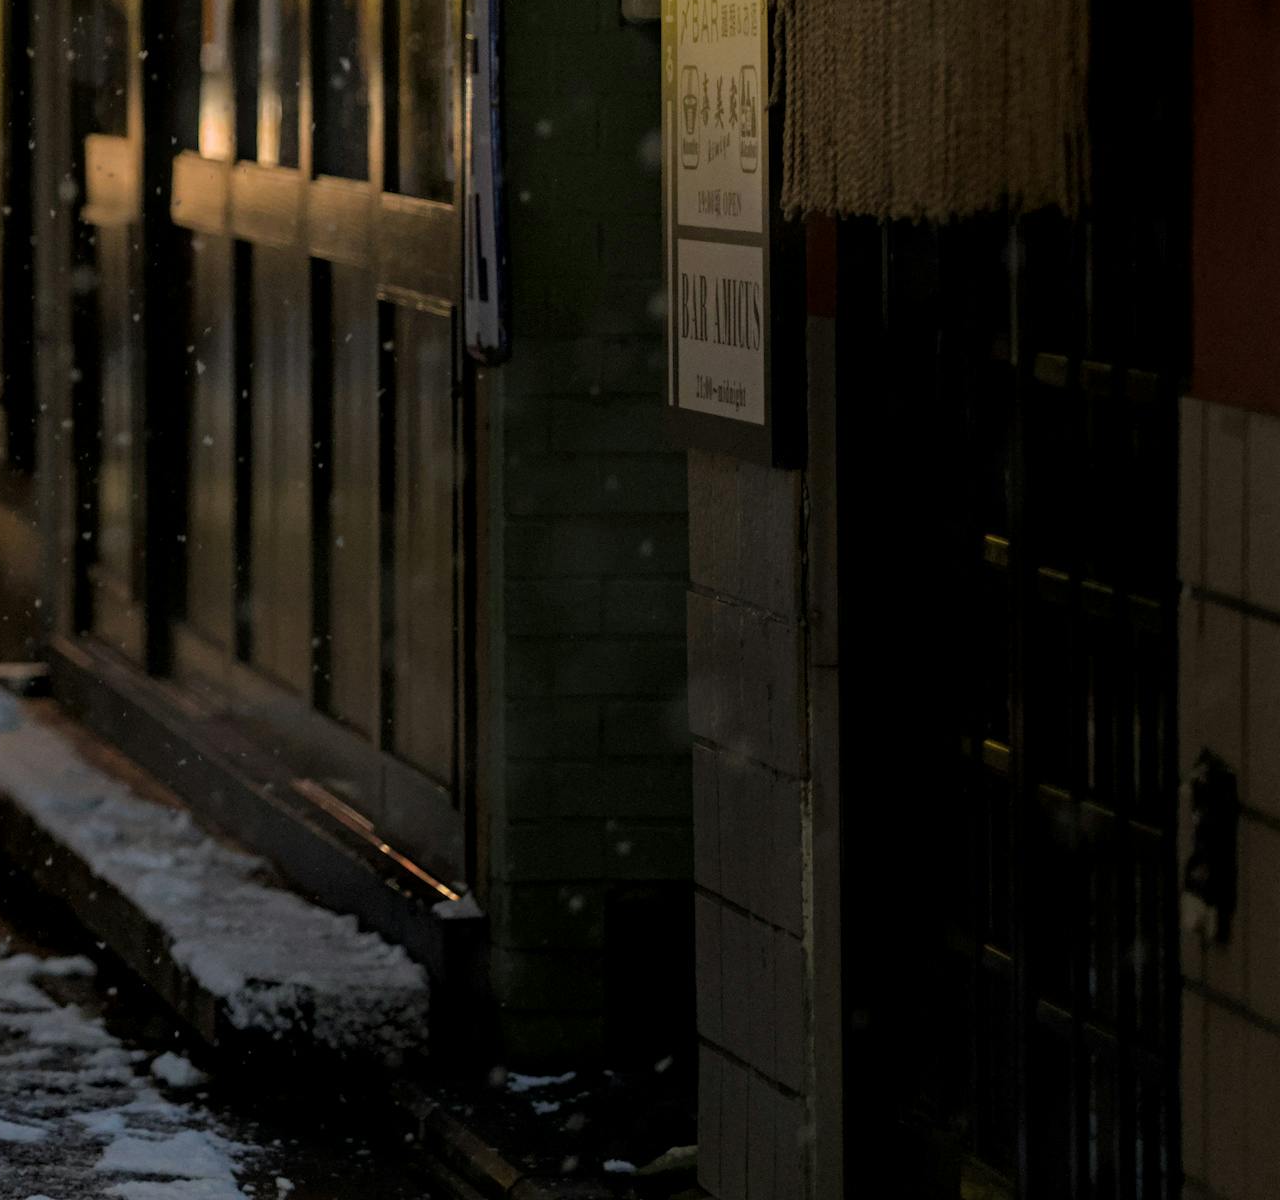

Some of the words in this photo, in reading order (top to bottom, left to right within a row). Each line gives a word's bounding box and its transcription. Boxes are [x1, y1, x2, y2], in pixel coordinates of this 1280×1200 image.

[723, 192, 743, 218] OPEN
[681, 272, 708, 341] BAR
[713, 276, 761, 352] AMICUS
